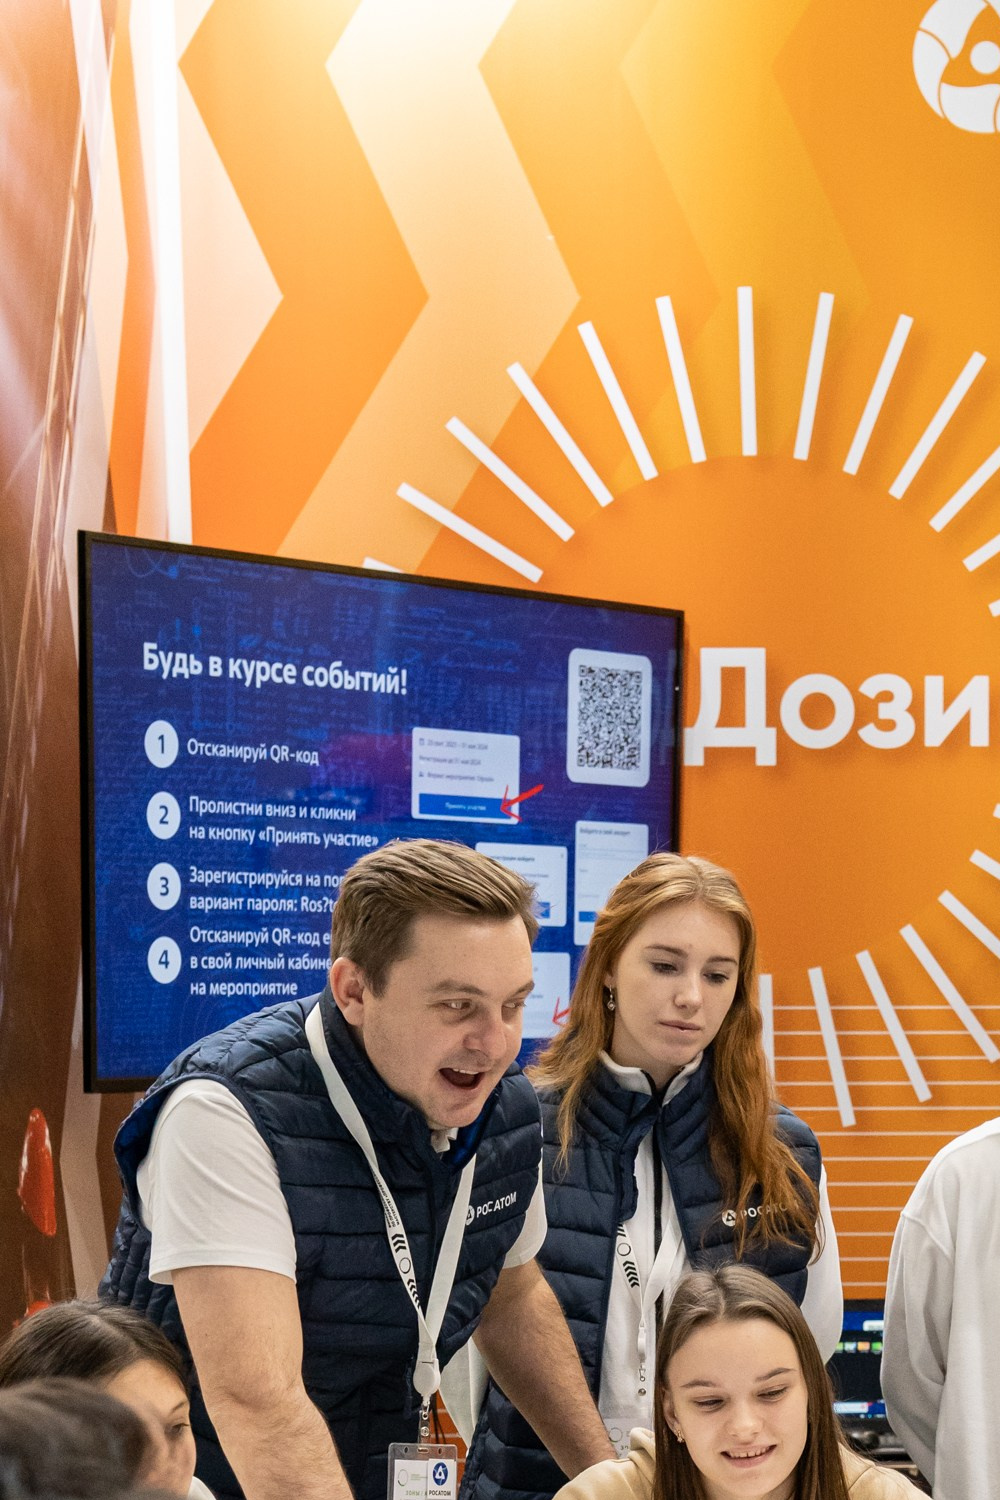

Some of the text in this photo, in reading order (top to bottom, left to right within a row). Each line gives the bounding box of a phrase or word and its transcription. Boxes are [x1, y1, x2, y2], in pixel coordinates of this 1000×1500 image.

[143, 642, 408, 696] Будь в курсе событий!
[157, 734, 319, 766] 1 Отсканируй QR-код
[159, 796, 356, 825] 2 Пролистни вниз и кликни
[189, 826, 379, 849] на кнопку «Принять участие»
[159, 877, 169, 896] 3
[189, 866, 302, 889] Зарегистрируйся
[306, 873, 321, 887] на
[189, 896, 244, 913] вариант
[247, 897, 297, 914] пароля:
[158, 950, 170, 969] 4
[190, 926, 269, 947] Отсканируй
[272, 928, 320, 946] QR-код
[190, 957, 198, 969] в
[201, 953, 232, 970] свой
[235, 954, 285, 970] личный
[190, 982, 298, 997] на мероприятие
